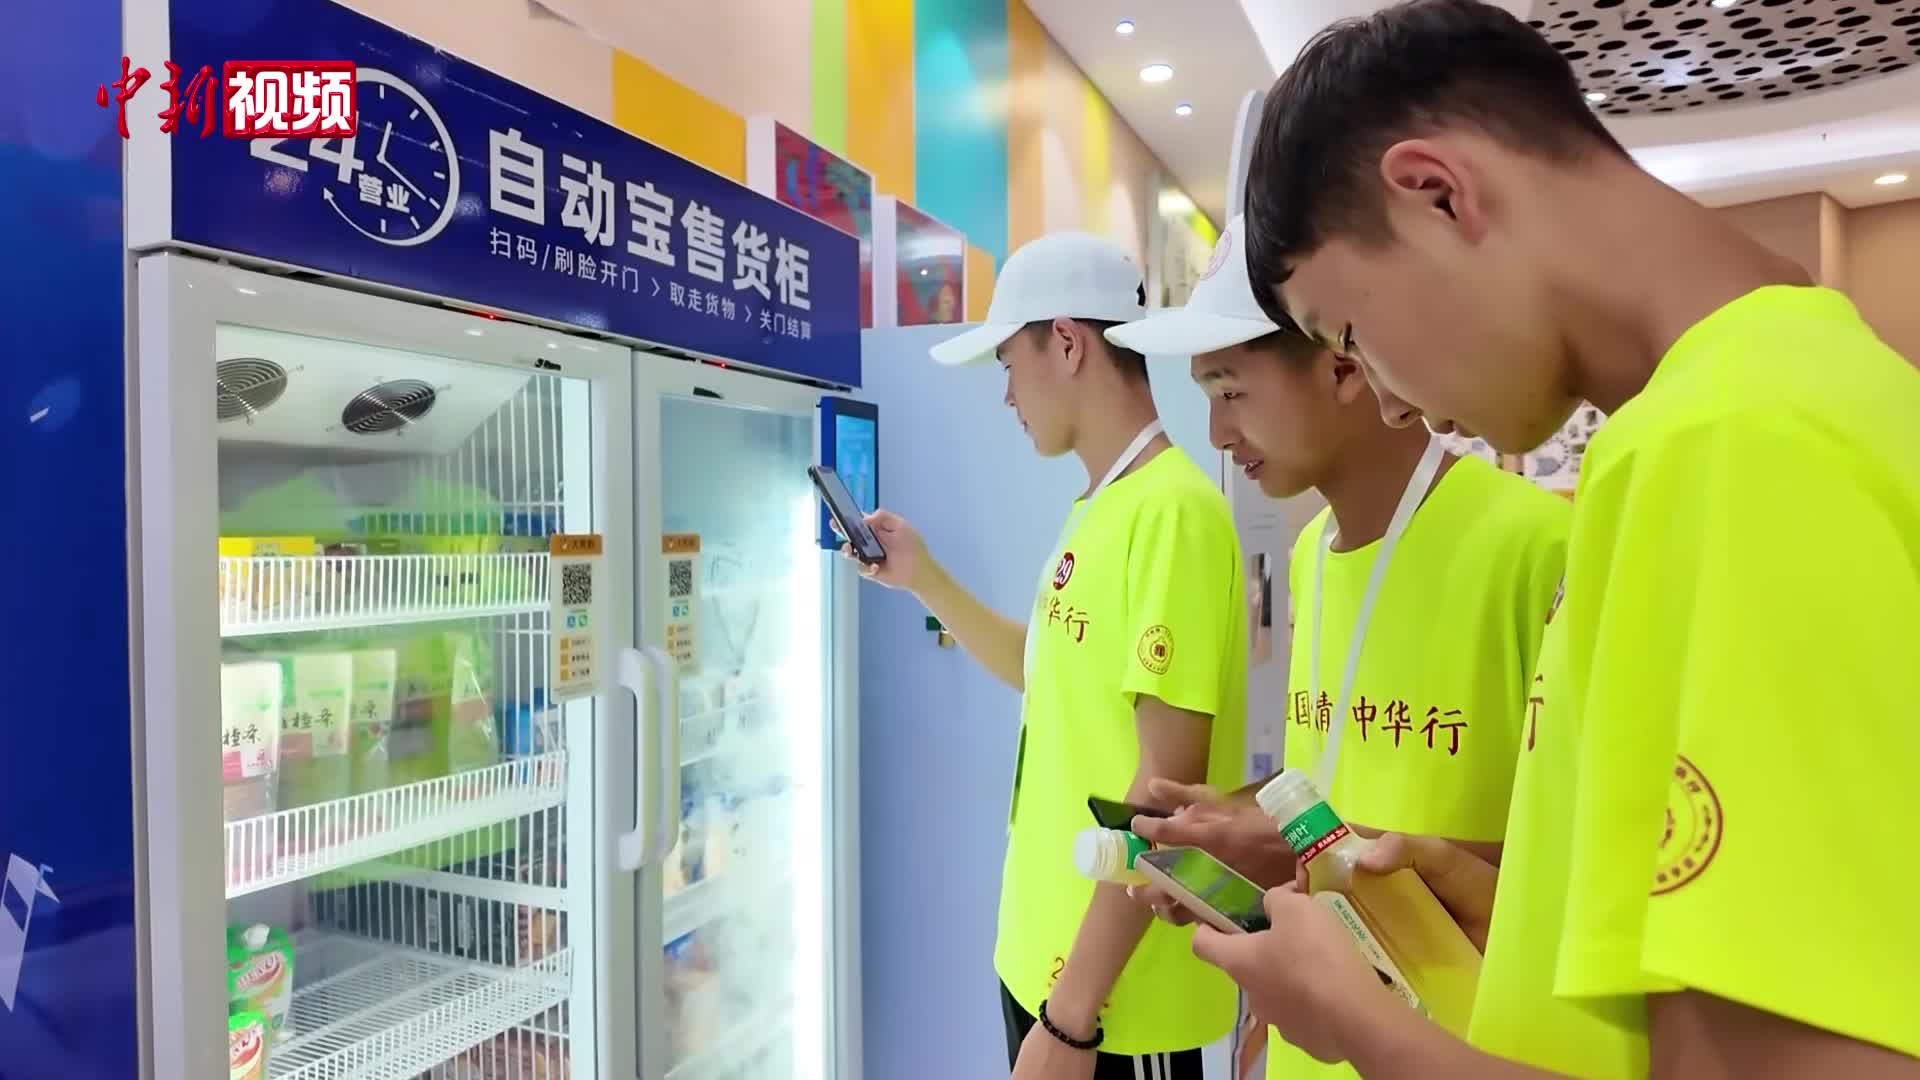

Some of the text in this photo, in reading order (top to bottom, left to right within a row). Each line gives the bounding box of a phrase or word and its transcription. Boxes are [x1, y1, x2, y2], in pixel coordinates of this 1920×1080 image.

[358, 174, 410, 214] 营业
[489, 128, 811, 311] 自动宝售货柜
[490, 226, 812, 340] 扫码/刷脸开门 取走货物 关门结算
[1352, 696, 1468, 756] 中华行
